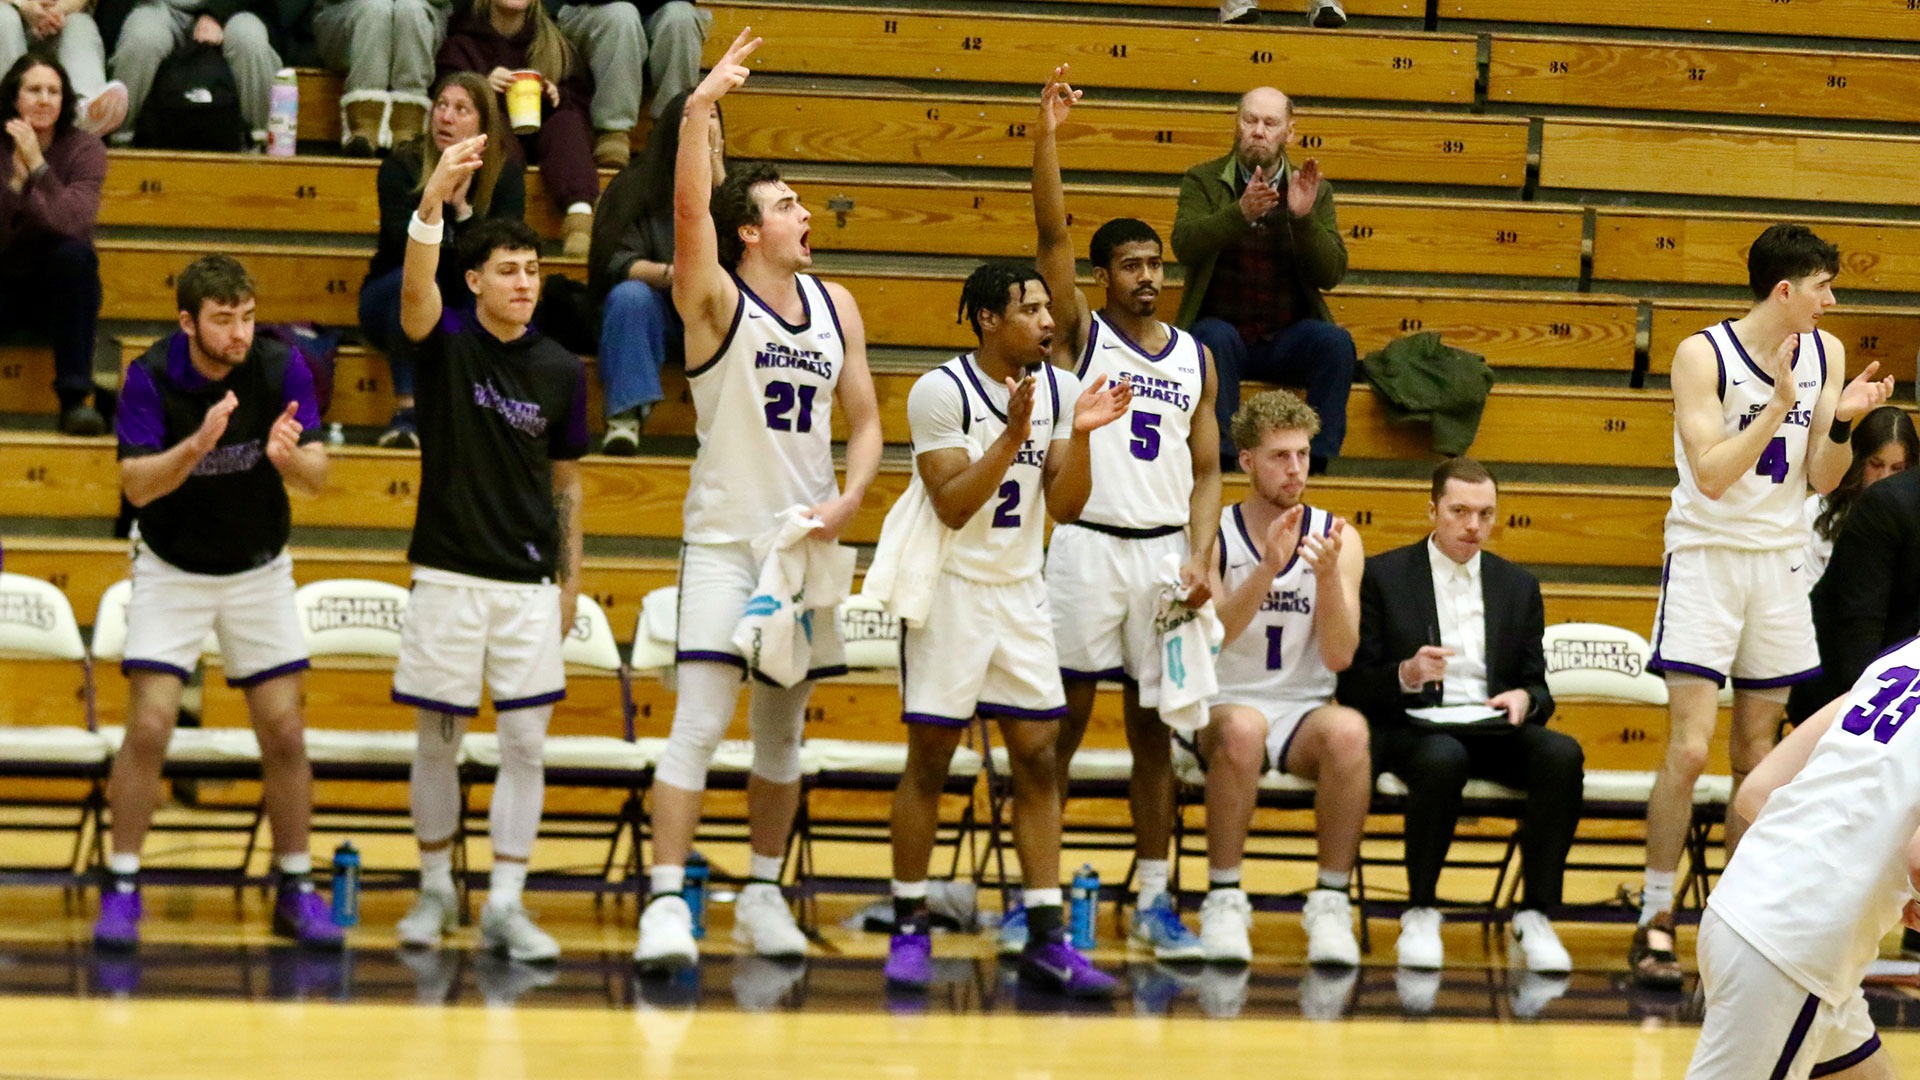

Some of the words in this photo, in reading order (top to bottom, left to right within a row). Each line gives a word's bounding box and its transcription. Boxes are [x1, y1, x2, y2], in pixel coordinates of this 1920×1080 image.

[884, 20, 897, 34] H
[961, 36, 982, 51] 42
[1108, 44, 1127, 58] 41
[1249, 50, 1273, 64] 40
[1392, 57, 1413, 70] 39
[1548, 60, 1569, 74] 38
[1688, 68, 1706, 81] 37
[1826, 75, 1847, 88] 36
[926, 108, 939, 121] G
[1005, 123, 1026, 138] 42
[1154, 130, 1173, 144] 41
[1300, 135, 1322, 149] 40
[1443, 140, 1464, 153] 39
[1347, 225, 1374, 239] 40
[1496, 230, 1517, 244] 39
[1655, 236, 1676, 249] 38
[1400, 318, 1422, 332] 40
[1549, 323, 1571, 336] 39
[1859, 335, 1879, 350] 37
[766, 342, 823, 360] SAINT
[755, 351, 832, 380] MICHAELS
[1119, 371, 1182, 391] SAINT
[1109, 380, 1190, 412] MCHAELS
[764, 380, 817, 433] 21
[1603, 419, 1626, 432] 39
[1129, 410, 1162, 461] 5
[1755, 436, 1790, 484] 4
[992, 479, 1021, 528] 2
[1354, 511, 1372, 525] 41
[1506, 514, 1531, 529] 40
[1265, 625, 1284, 671] 1
[1553, 639, 1628, 655] SAINT
[1543, 649, 1642, 678] MICHAELS
[1619, 727, 1646, 744] 40
